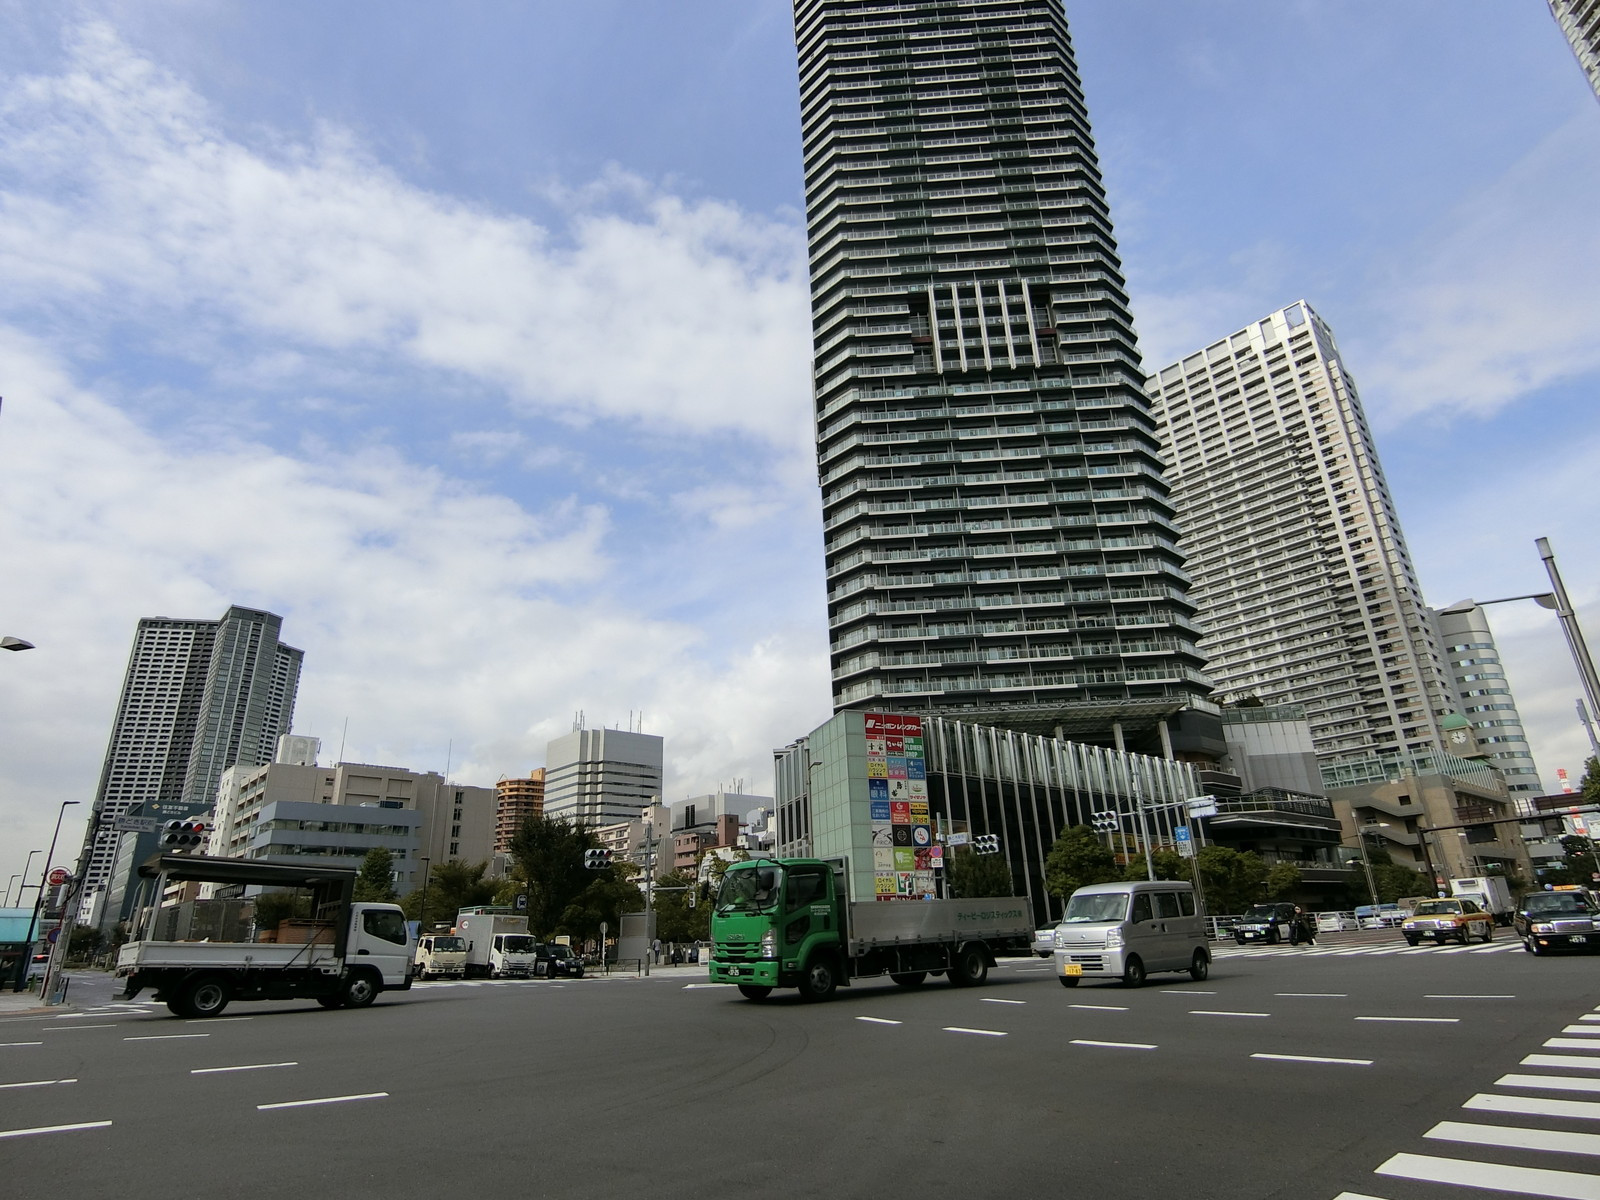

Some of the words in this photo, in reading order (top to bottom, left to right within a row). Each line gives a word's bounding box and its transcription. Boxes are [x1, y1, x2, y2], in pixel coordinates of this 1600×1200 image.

[875, 722, 923, 731] ニッポンレンタカー
